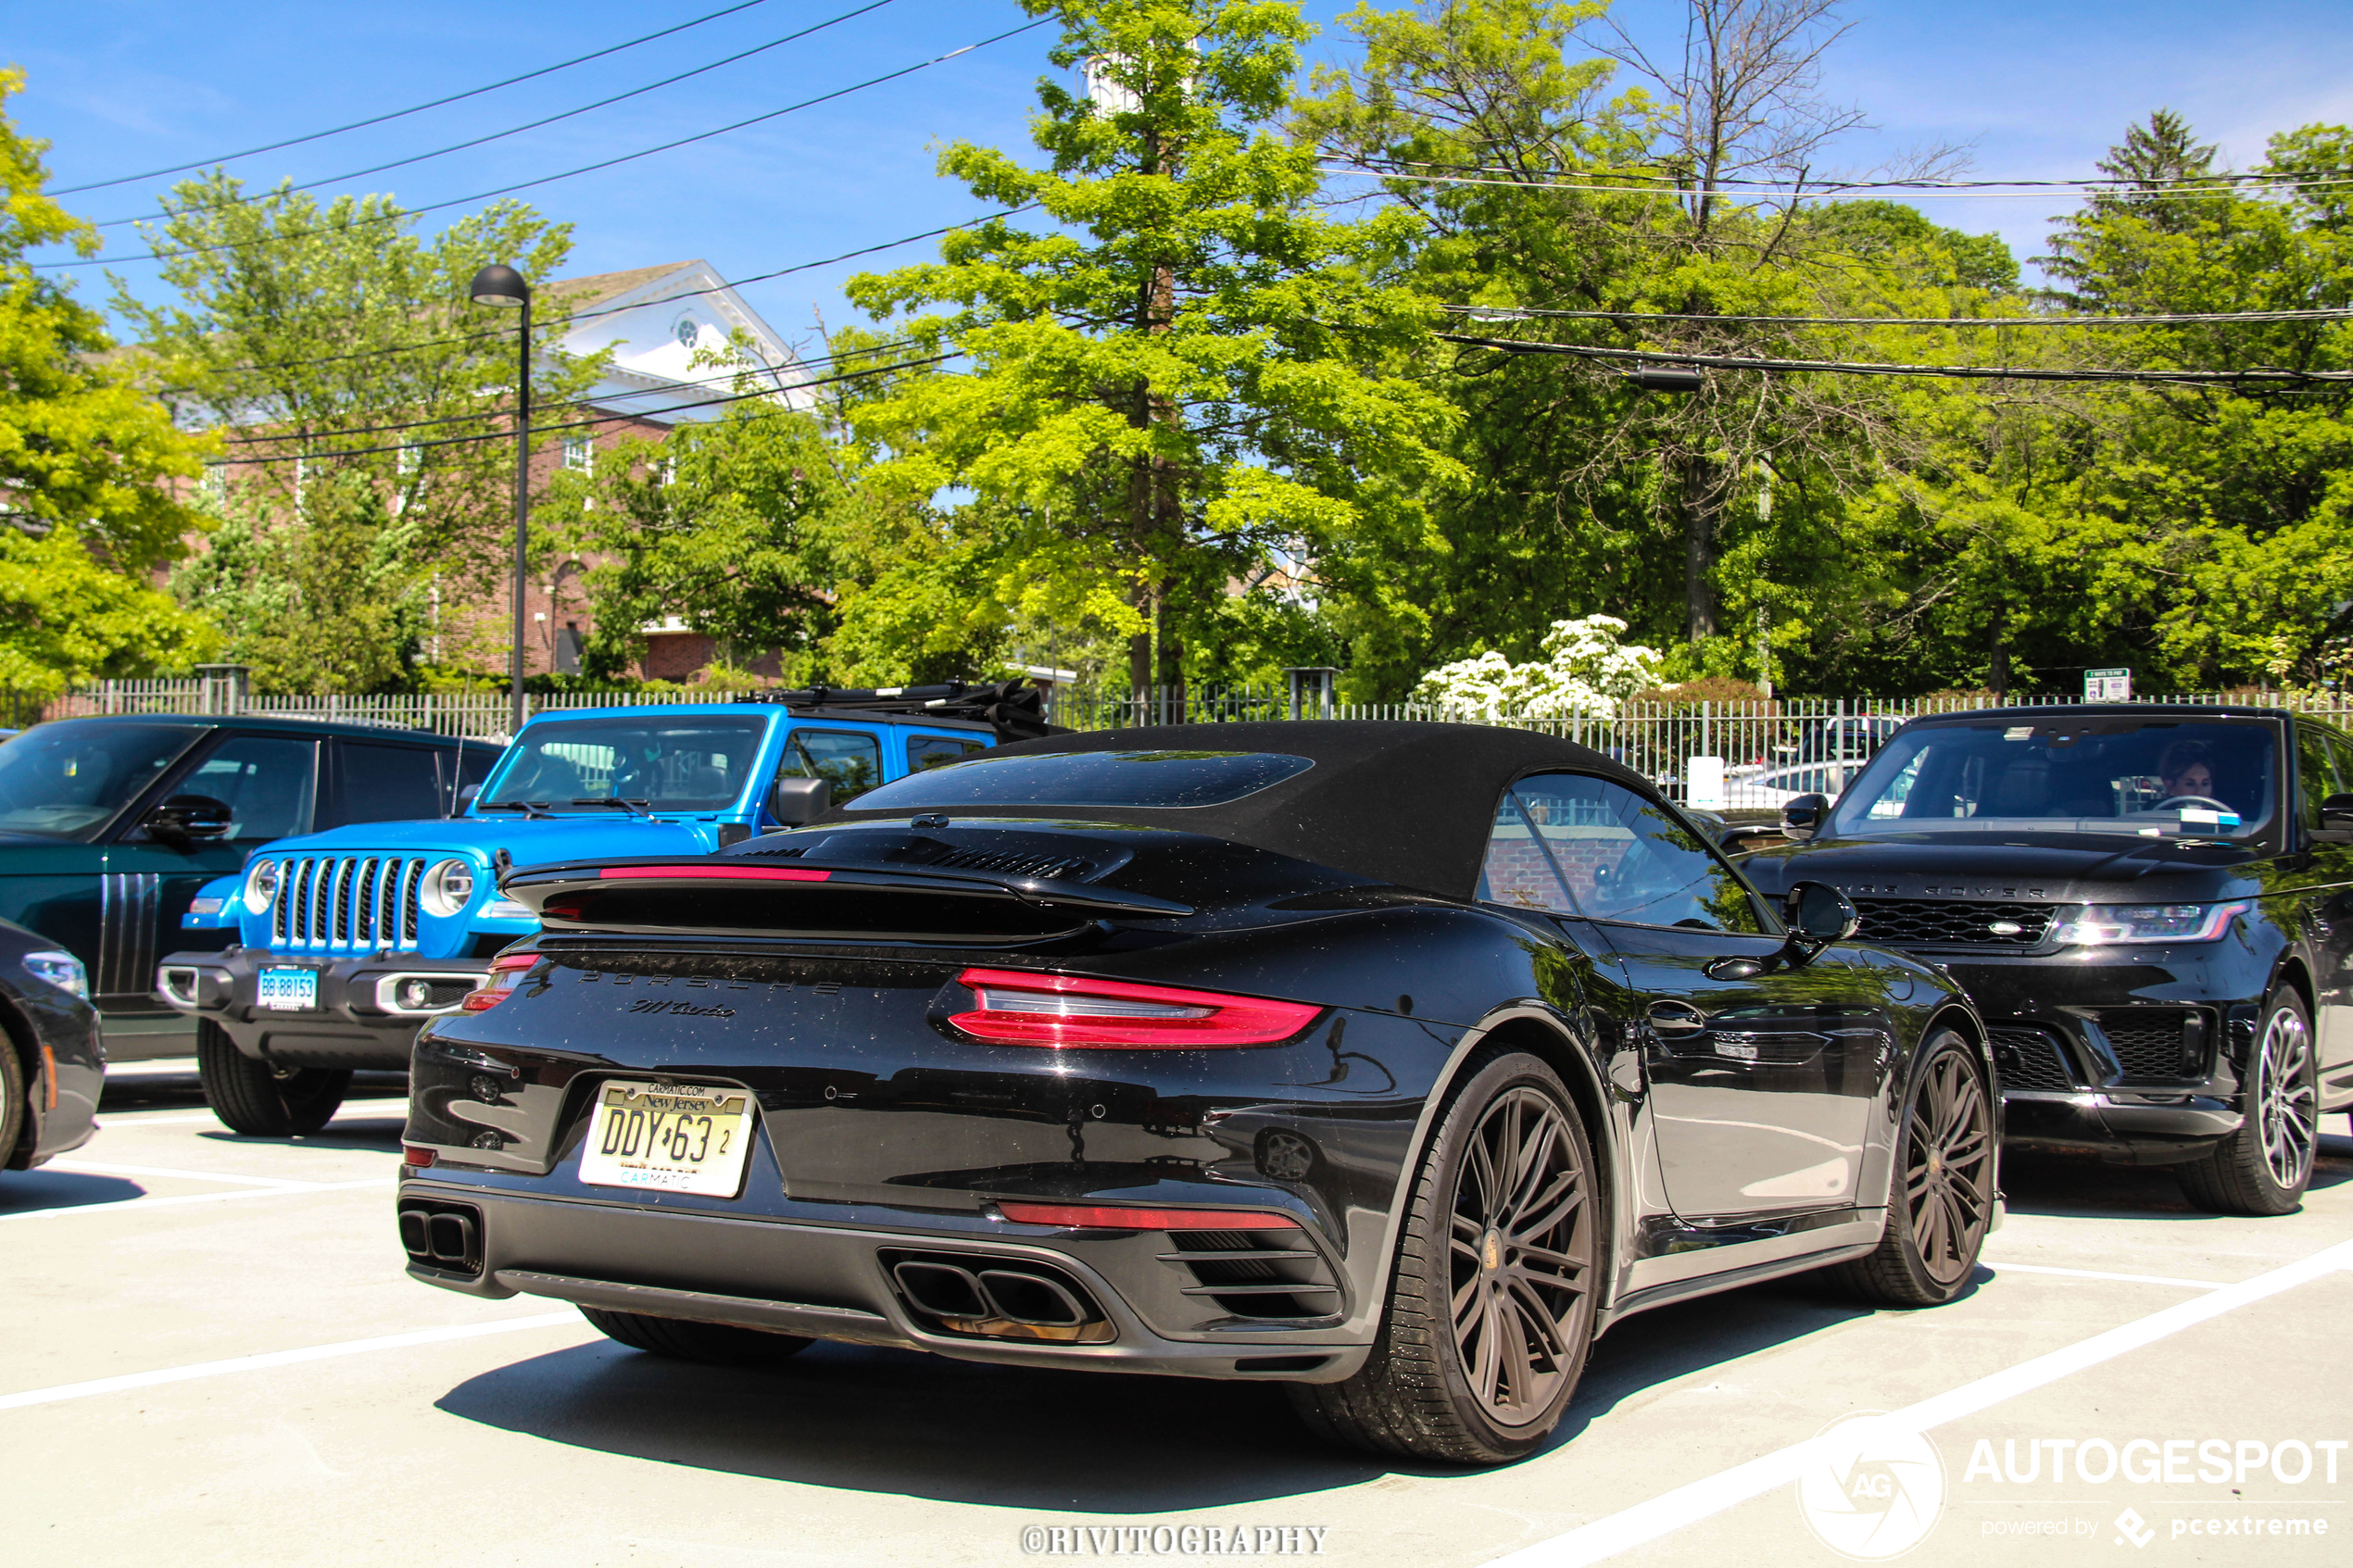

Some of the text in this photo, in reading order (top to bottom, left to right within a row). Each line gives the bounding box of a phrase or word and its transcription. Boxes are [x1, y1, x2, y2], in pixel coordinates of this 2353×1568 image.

[1925, 885, 2045, 898] ROVER
[577, 972, 842, 995] PORSCHE
[629, 997, 673, 1013] 911
[648, 1084, 706, 1097] CARMATIC.COM
[642, 1095, 709, 1115] New Jersey
[621, 1171, 690, 1190] CARMATIC
